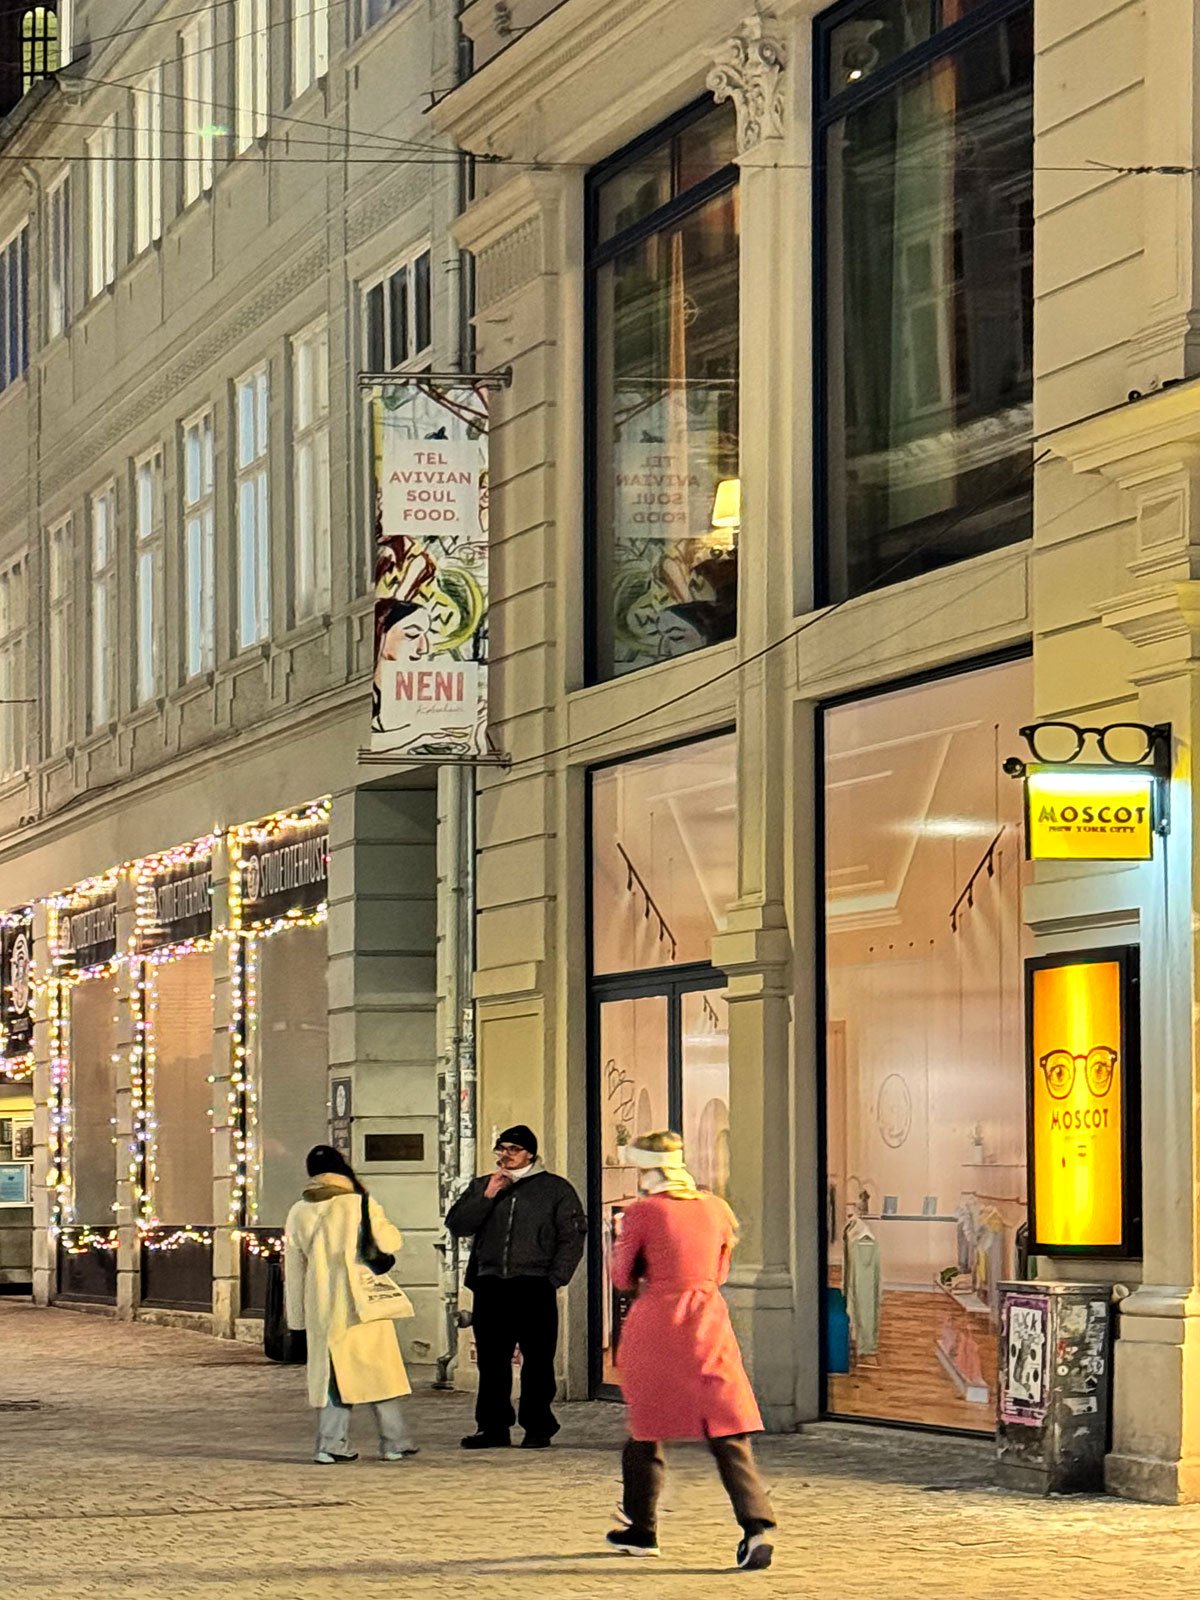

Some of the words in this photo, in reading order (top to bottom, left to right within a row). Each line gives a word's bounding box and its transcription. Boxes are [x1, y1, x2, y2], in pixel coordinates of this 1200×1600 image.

[413, 452, 448, 465] TEL
[389, 470, 472, 485] AVIVIAN
[406, 489, 456, 503] SOUL
[402, 508, 460, 521] FOOD.
[395, 670, 464, 702] NENI
[1038, 805, 1146, 824] MOSCOT
[1076, 825, 1107, 833] YORK
[1051, 1108, 1109, 1131] MOSCOT
